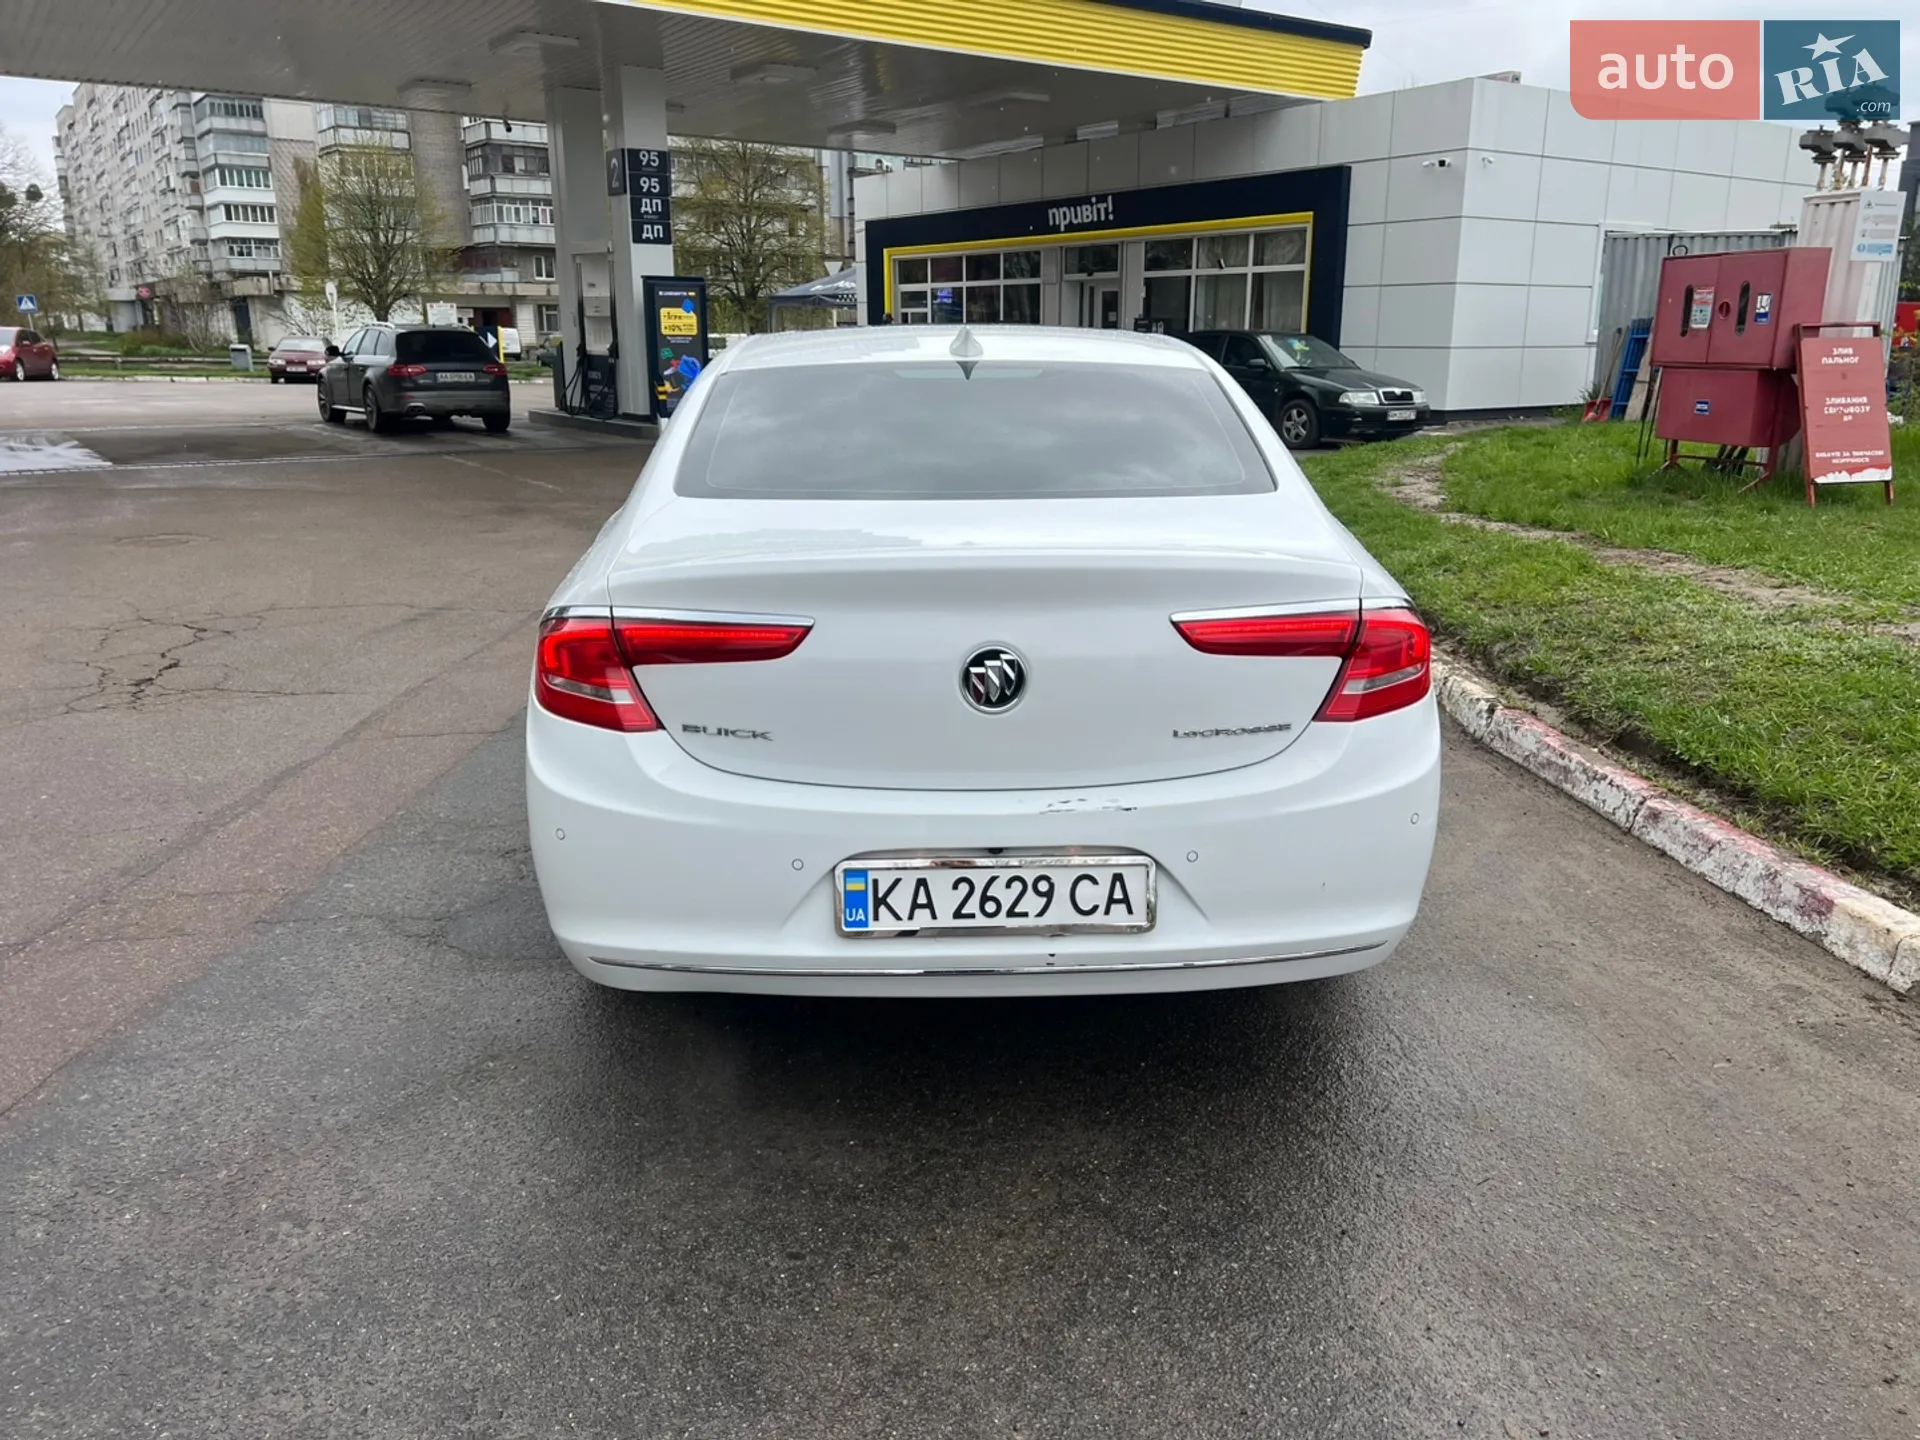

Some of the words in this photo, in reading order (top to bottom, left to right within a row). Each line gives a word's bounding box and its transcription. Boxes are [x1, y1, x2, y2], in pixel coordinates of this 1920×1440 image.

[639, 150, 660, 167] 95
[610, 157, 620, 188] 2
[640, 176, 661, 193] 95
[641, 198, 662, 214] ДП
[1048, 194, 1114, 232] привіт!
[642, 224, 663, 240] ДП
[682, 724, 773, 741] BUICK
[846, 908, 865, 921] UA
[872, 878, 938, 921] KA
[951, 874, 1055, 919] 2629
[1069, 872, 1134, 916] CA
